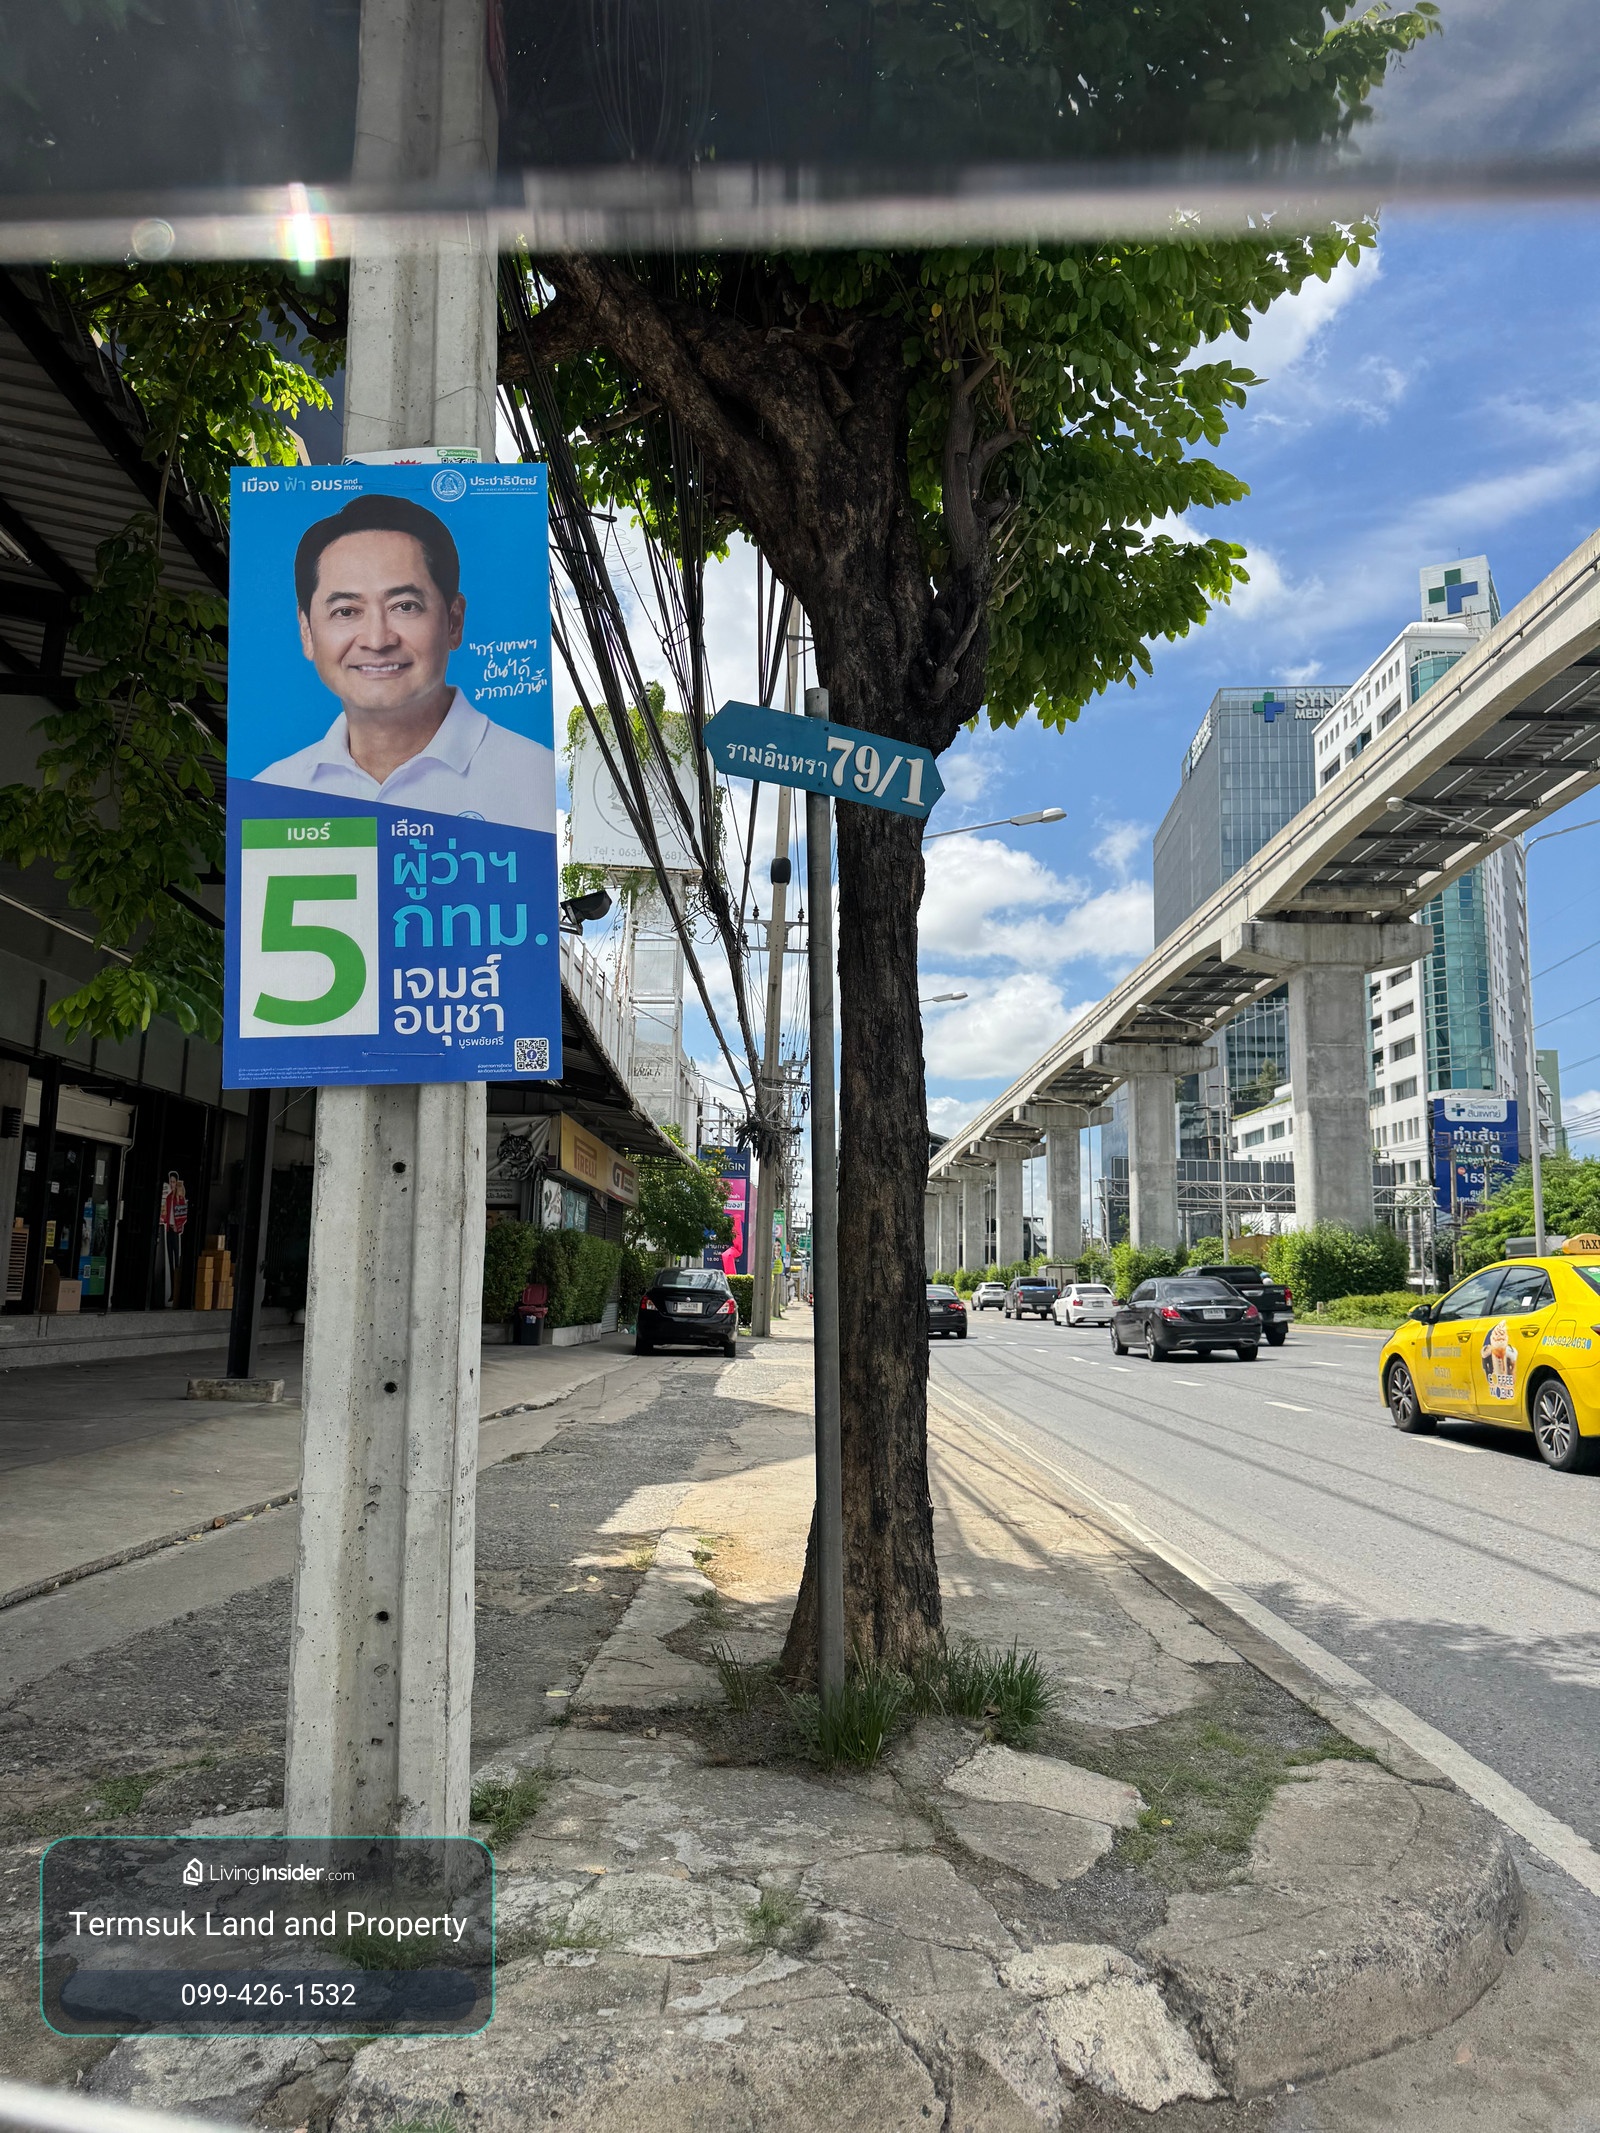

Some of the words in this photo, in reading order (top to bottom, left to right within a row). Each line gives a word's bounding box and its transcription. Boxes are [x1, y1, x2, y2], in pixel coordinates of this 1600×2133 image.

[241, 477, 280, 492] เมือง
[284, 477, 306, 491] ฟ้า
[311, 479, 343, 491] อมร
[470, 475, 538, 486] ประชาธิปัตย์
[483, 656, 531, 682] เป็นได้
[726, 743, 828, 778] รามอินทรา
[827, 736, 925, 807] 79/1
[287, 822, 331, 841] เบอร์
[391, 818, 435, 837] เลือก
[594, 846, 608, 855] Tel
[393, 838, 517, 900] ผู้ว่าฯ
[392, 904, 549, 948] กทม.
[253, 874, 367, 1026] 5
[393, 953, 502, 1000] เจมส์
[394, 1003, 505, 1047] อนุชา
[458, 1036, 504, 1050] บูรพชัยศรี
[574, 1135, 598, 1180] PIRELLI
